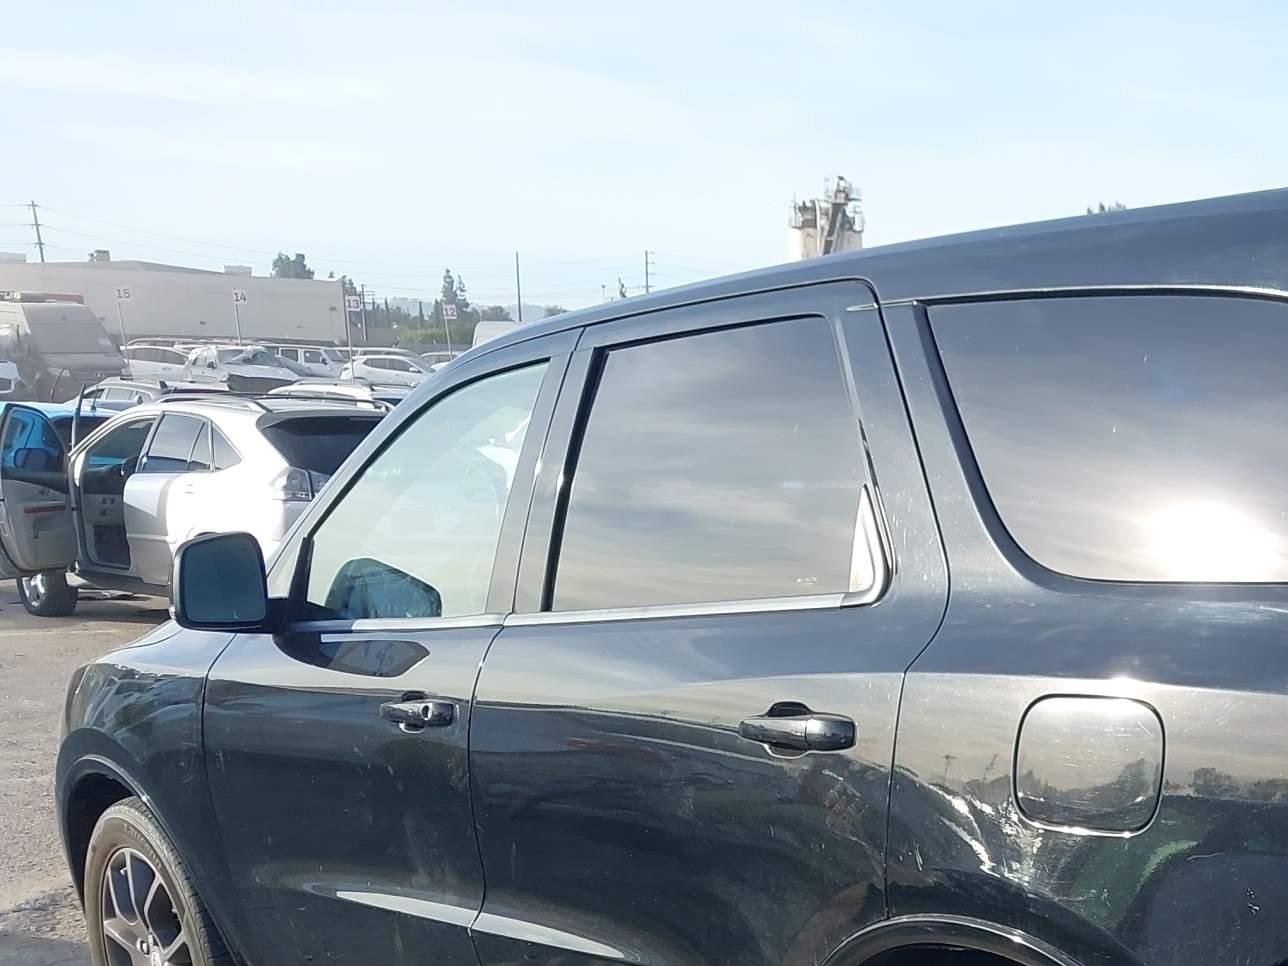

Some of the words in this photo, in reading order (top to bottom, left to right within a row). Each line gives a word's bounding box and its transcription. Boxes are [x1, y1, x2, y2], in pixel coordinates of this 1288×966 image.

[115, 288, 132, 300] 15
[233, 291, 248, 303] 14
[345, 298, 361, 310] 13
[443, 307, 458, 318] 12
